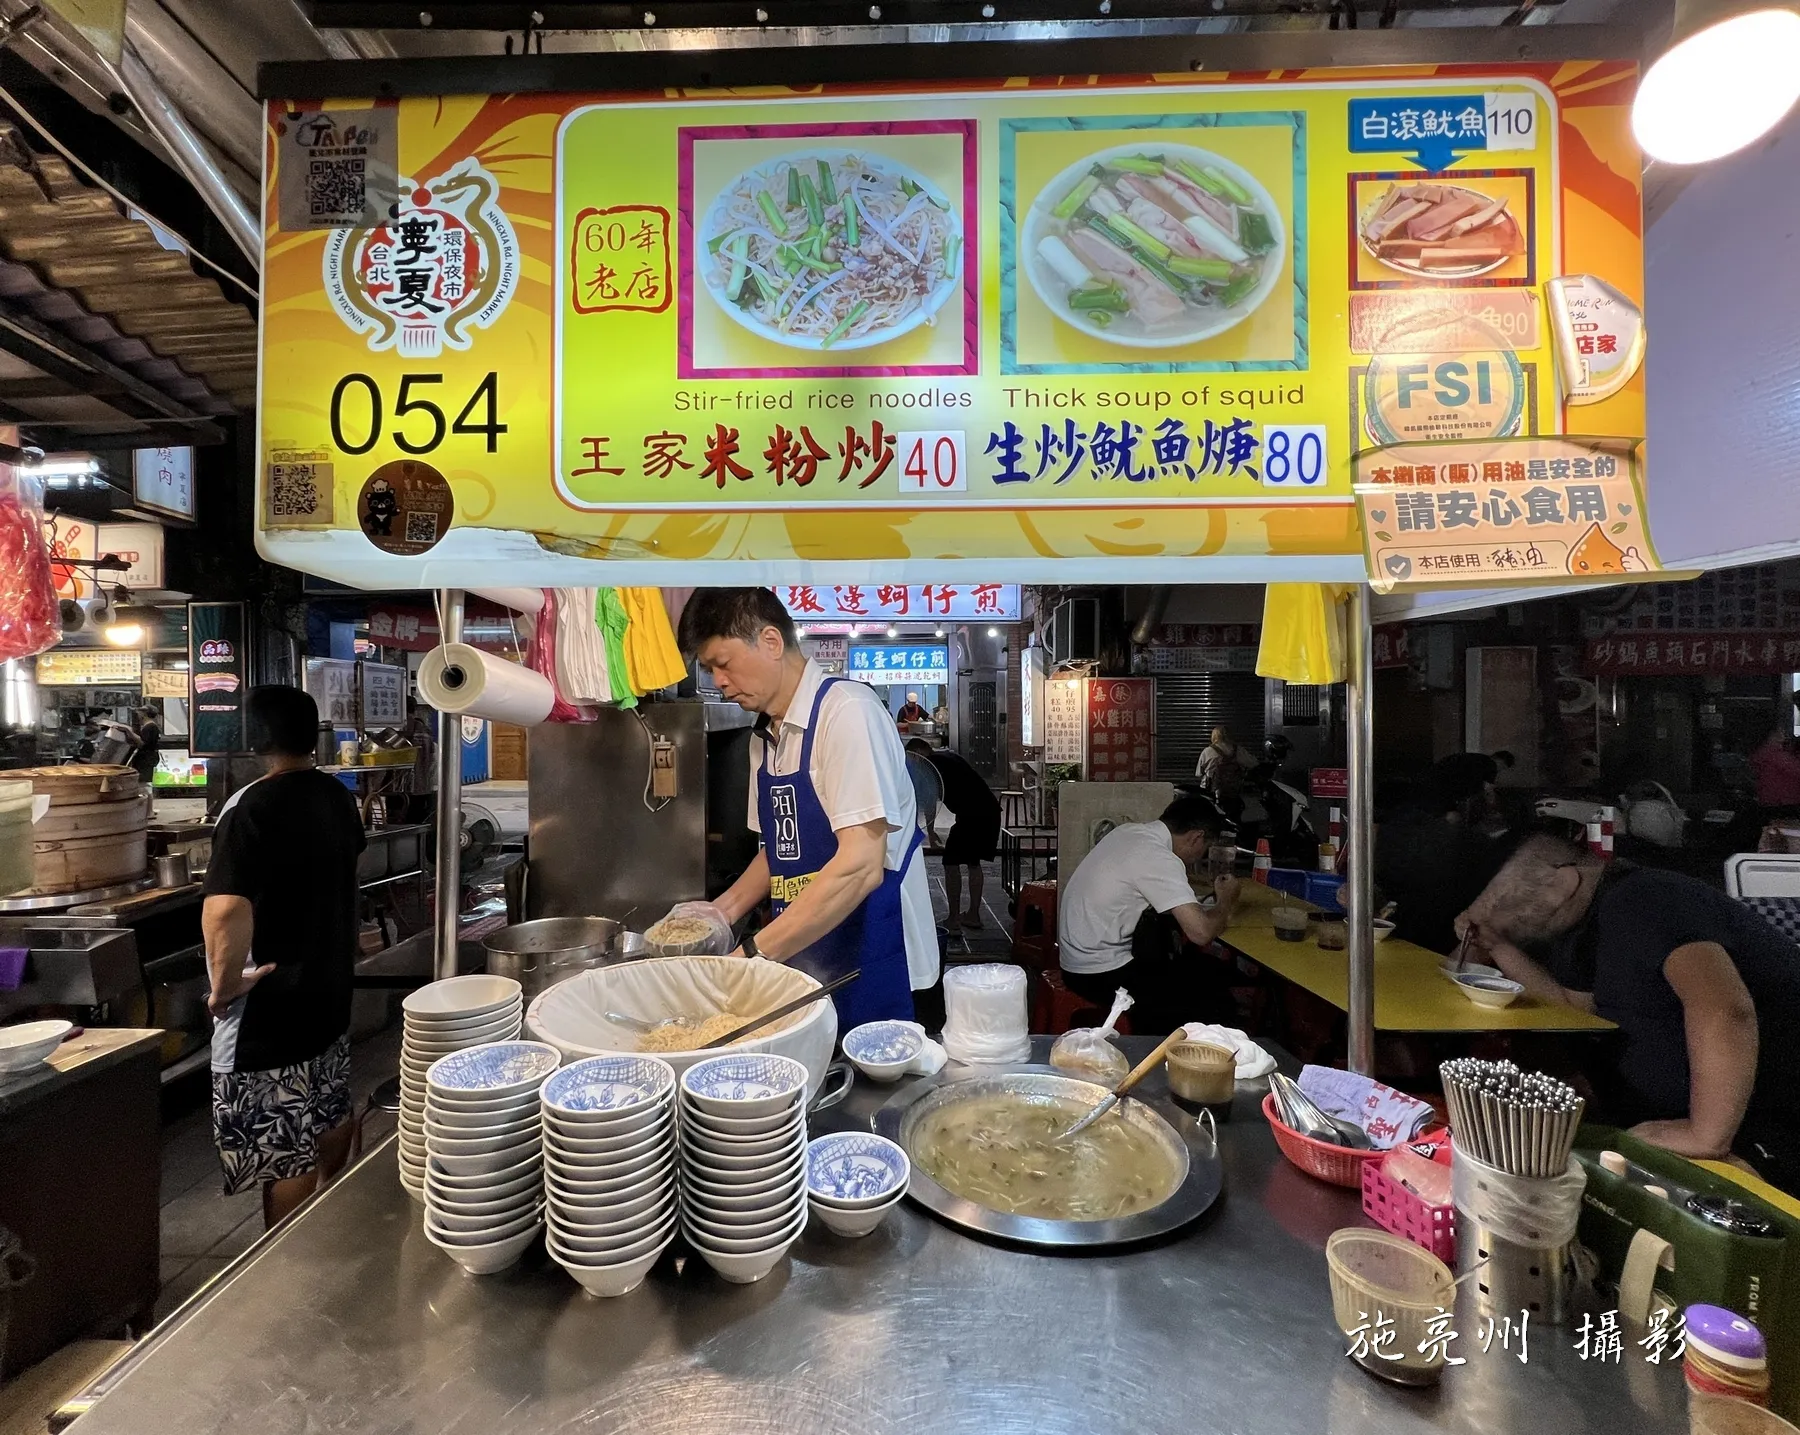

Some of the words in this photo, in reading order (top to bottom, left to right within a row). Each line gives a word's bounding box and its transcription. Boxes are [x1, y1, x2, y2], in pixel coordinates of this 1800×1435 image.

[1362, 106, 1486, 141] 白滾魷魚
[1488, 109, 1533, 136] 110
[487, 211, 510, 245] NINGXIA
[585, 220, 661, 254] 60年
[331, 254, 339, 279] NIGHT
[370, 245, 390, 282] 台北
[382, 217, 445, 313] 寧夏
[443, 231, 462, 297] 環保夜市
[503, 262, 513, 291] NIGHT
[585, 262, 661, 302] 老店
[338, 296, 365, 326] NINGXIA
[481, 290, 507, 322] MARKET
[1501, 312, 1528, 336] 90
[1576, 334, 1618, 355] 店家
[674, 389, 794, 411] Stir-fried
[807, 390, 855, 409] rice
[869, 388, 972, 409] noodles
[1003, 388, 1087, 408] Thick
[1097, 390, 1173, 411] soup
[1181, 386, 1211, 405] of
[1219, 384, 1305, 410] squid
[1397, 361, 1492, 409] FSI
[330, 371, 508, 456] 054
[571, 420, 898, 490] 王家米粉炒
[903, 436, 958, 488] 40
[1265, 431, 1322, 485] 80
[1395, 485, 1608, 532] 請安心食用
[772, 584, 1005, 616] 環邊蚵仔煎
